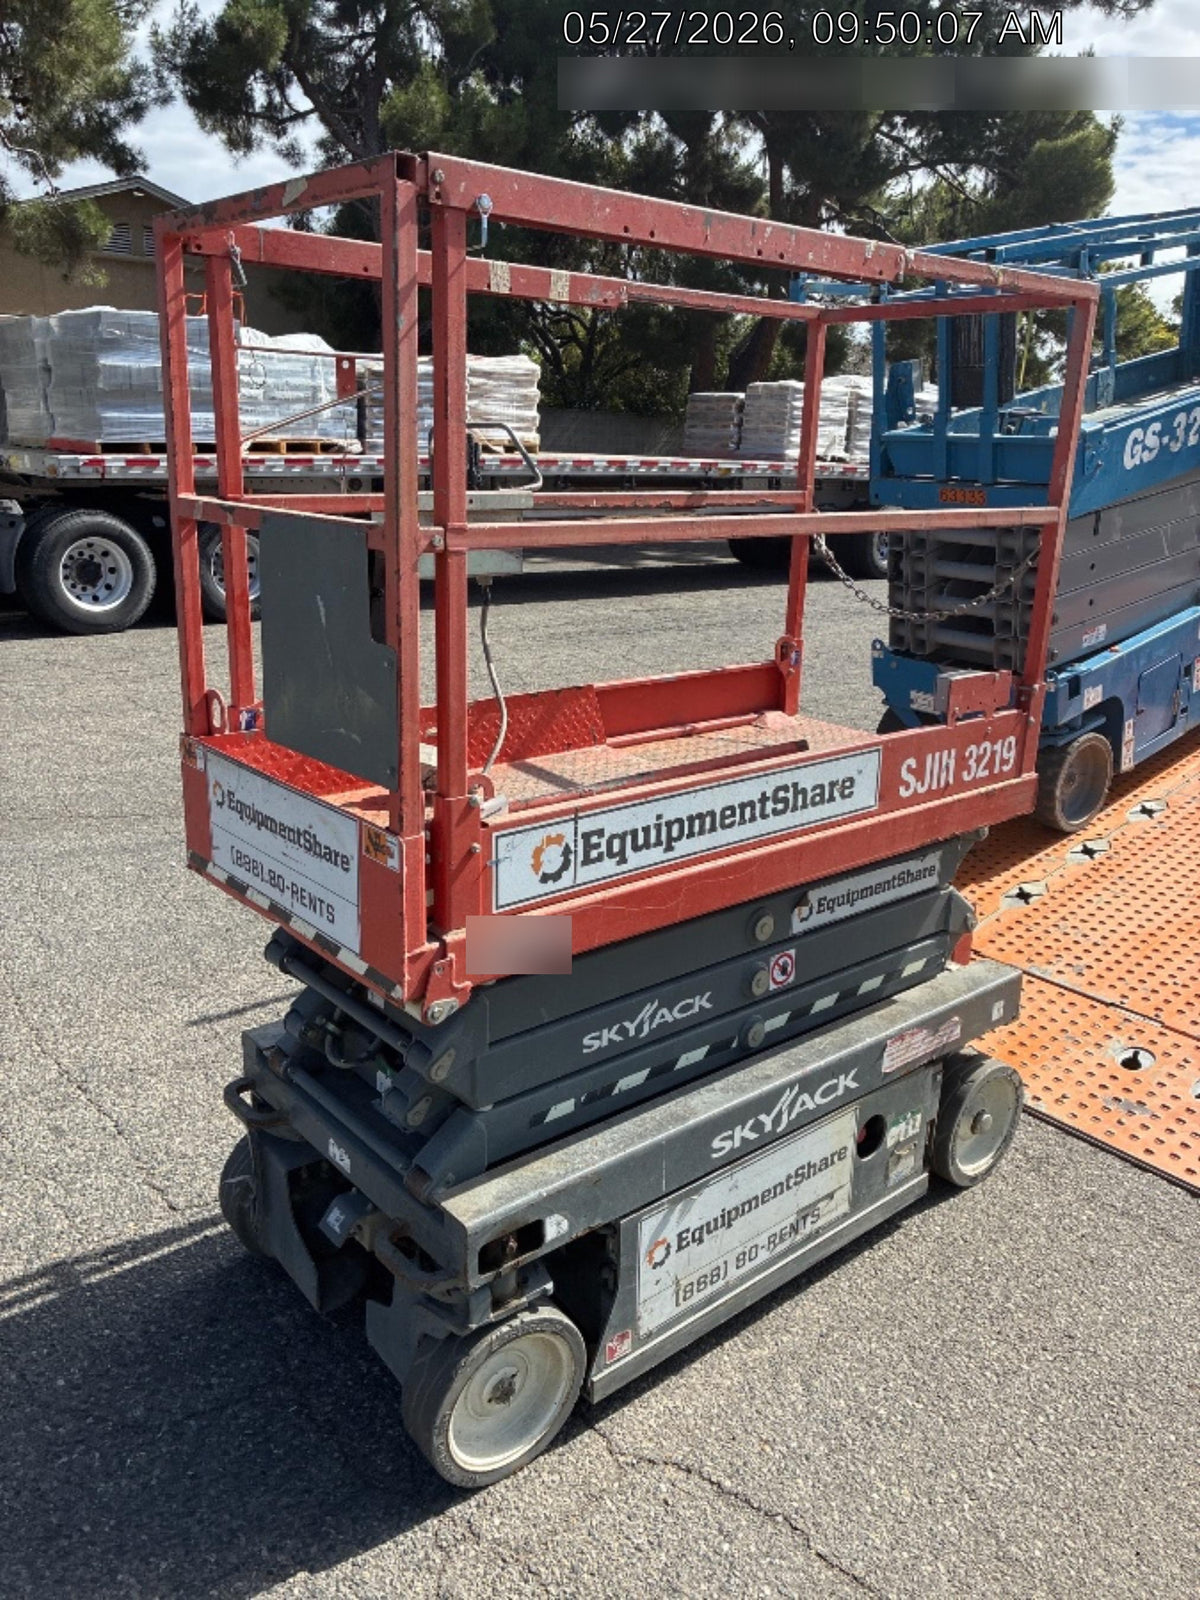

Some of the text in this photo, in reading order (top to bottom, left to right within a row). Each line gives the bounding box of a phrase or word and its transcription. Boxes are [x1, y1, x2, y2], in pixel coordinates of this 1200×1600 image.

[962, 735, 1016, 781] 3219
[226, 790, 351, 874] EquipmentShare
[580, 775, 856, 867] EquipmentShare
[815, 864, 937, 915] EquipmentShare
[582, 991, 713, 1054] SKYJACK
[710, 1067, 860, 1160] SKYJACK
[675, 1144, 849, 1254] EquipmentShare
[674, 1206, 822, 1308] (888) 80-RENTS
